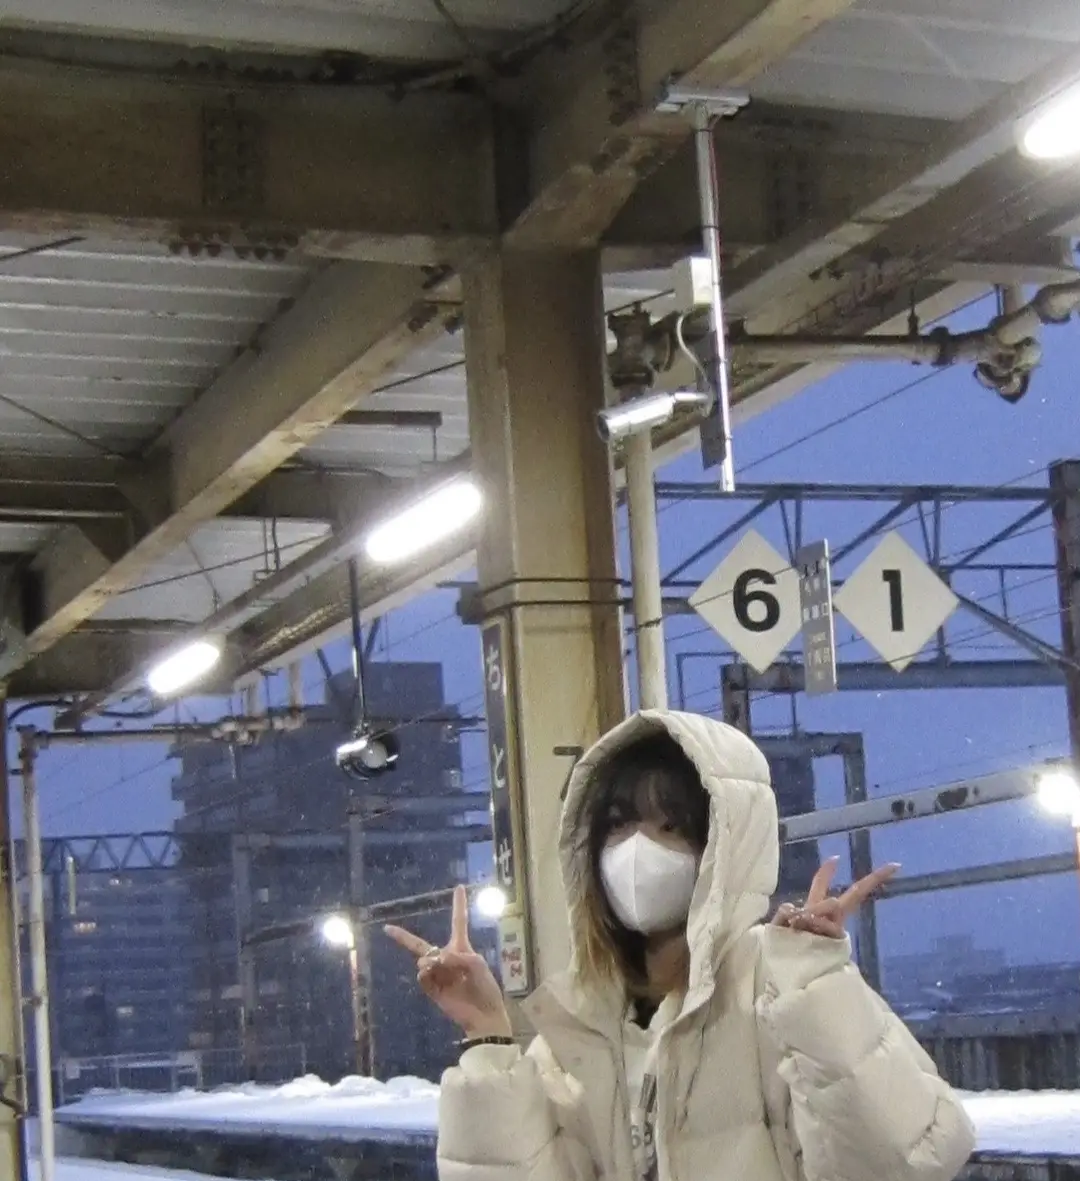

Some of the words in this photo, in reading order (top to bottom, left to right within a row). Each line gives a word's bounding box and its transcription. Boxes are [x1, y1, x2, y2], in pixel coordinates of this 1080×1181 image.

[733, 568, 780, 632] 6
[882, 569, 904, 632] 1
[486, 644, 513, 885] ちとせ
[552, 745, 585, 802] 7
